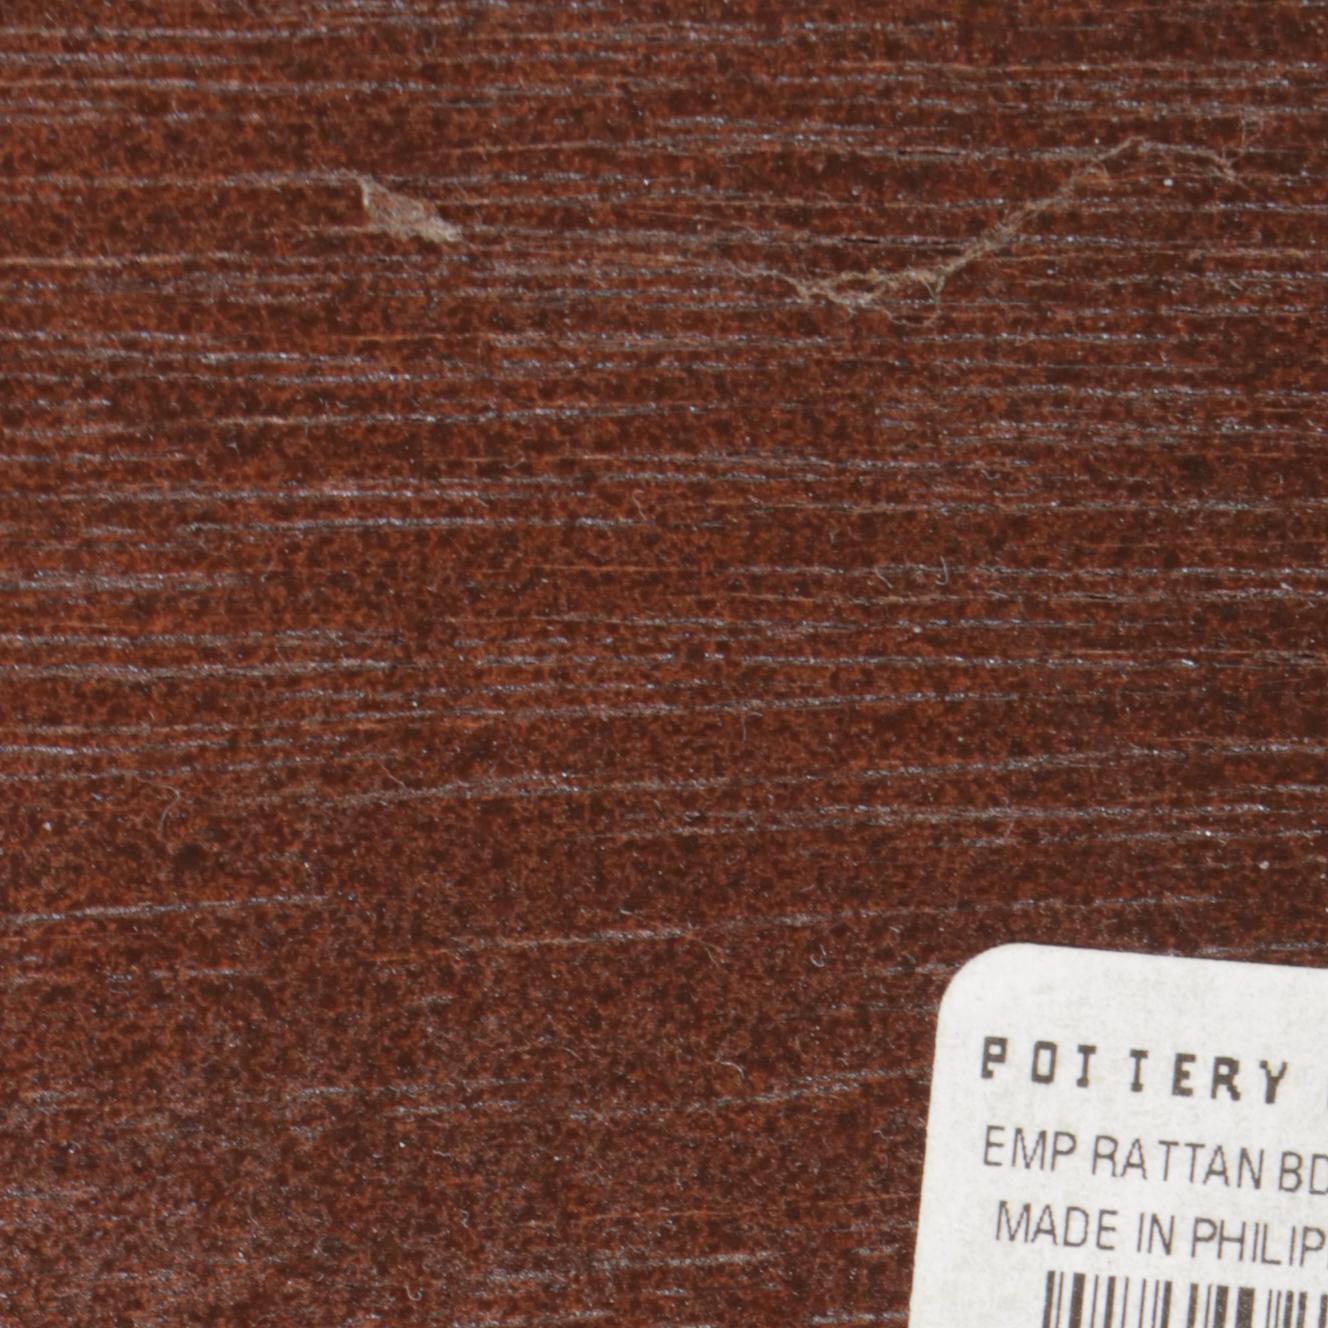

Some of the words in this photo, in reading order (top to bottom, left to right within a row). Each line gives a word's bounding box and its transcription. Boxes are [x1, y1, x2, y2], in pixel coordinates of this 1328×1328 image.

[980, 1036, 1288, 1104] POTTERY
[982, 1124, 1077, 1172] EMP
[1091, 1134, 1264, 1190] RATTAN
[994, 1200, 1119, 1251] MADE
[1136, 1212, 1175, 1256] IN
